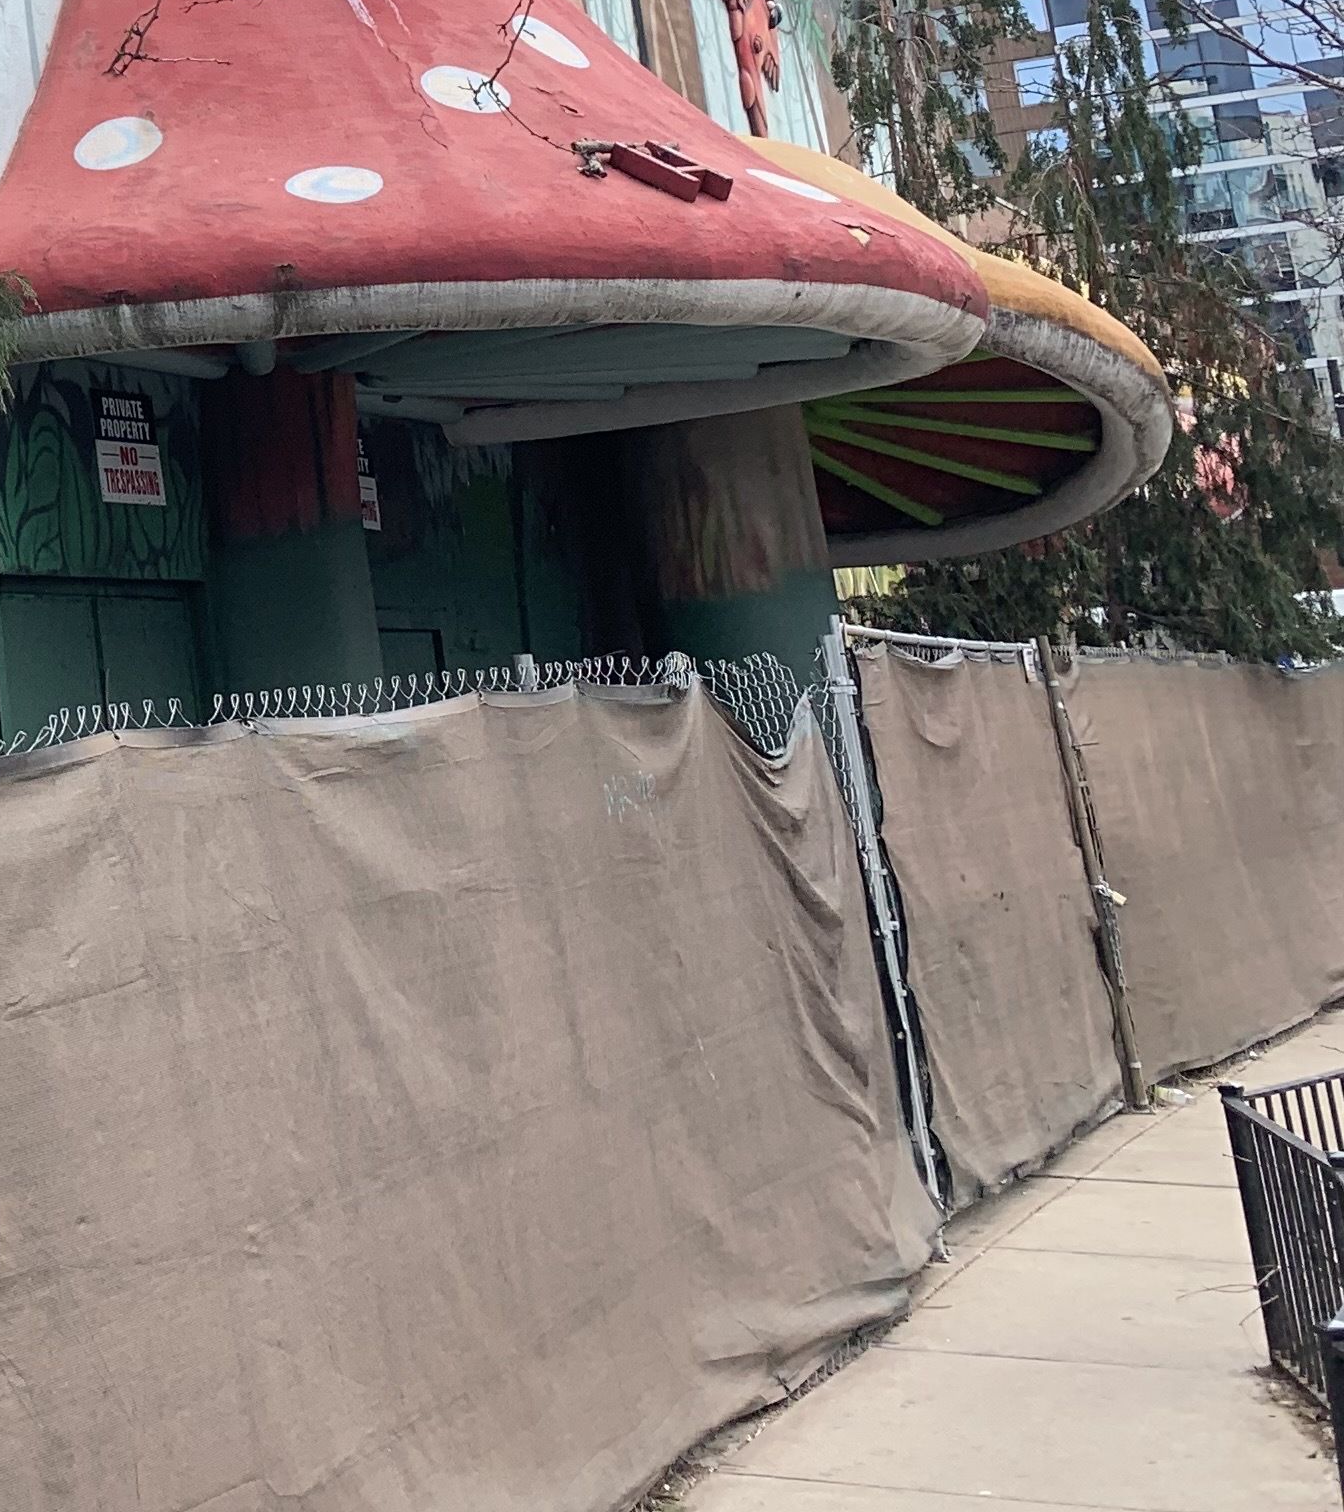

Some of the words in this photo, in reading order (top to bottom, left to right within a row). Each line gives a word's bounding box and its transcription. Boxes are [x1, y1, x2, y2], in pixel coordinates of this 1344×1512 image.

[101, 397, 144, 418] PRIVATE
[100, 419, 150, 440] PROPERTY
[119, 446, 138, 466] NO
[104, 467, 161, 496] TRESPASSING
